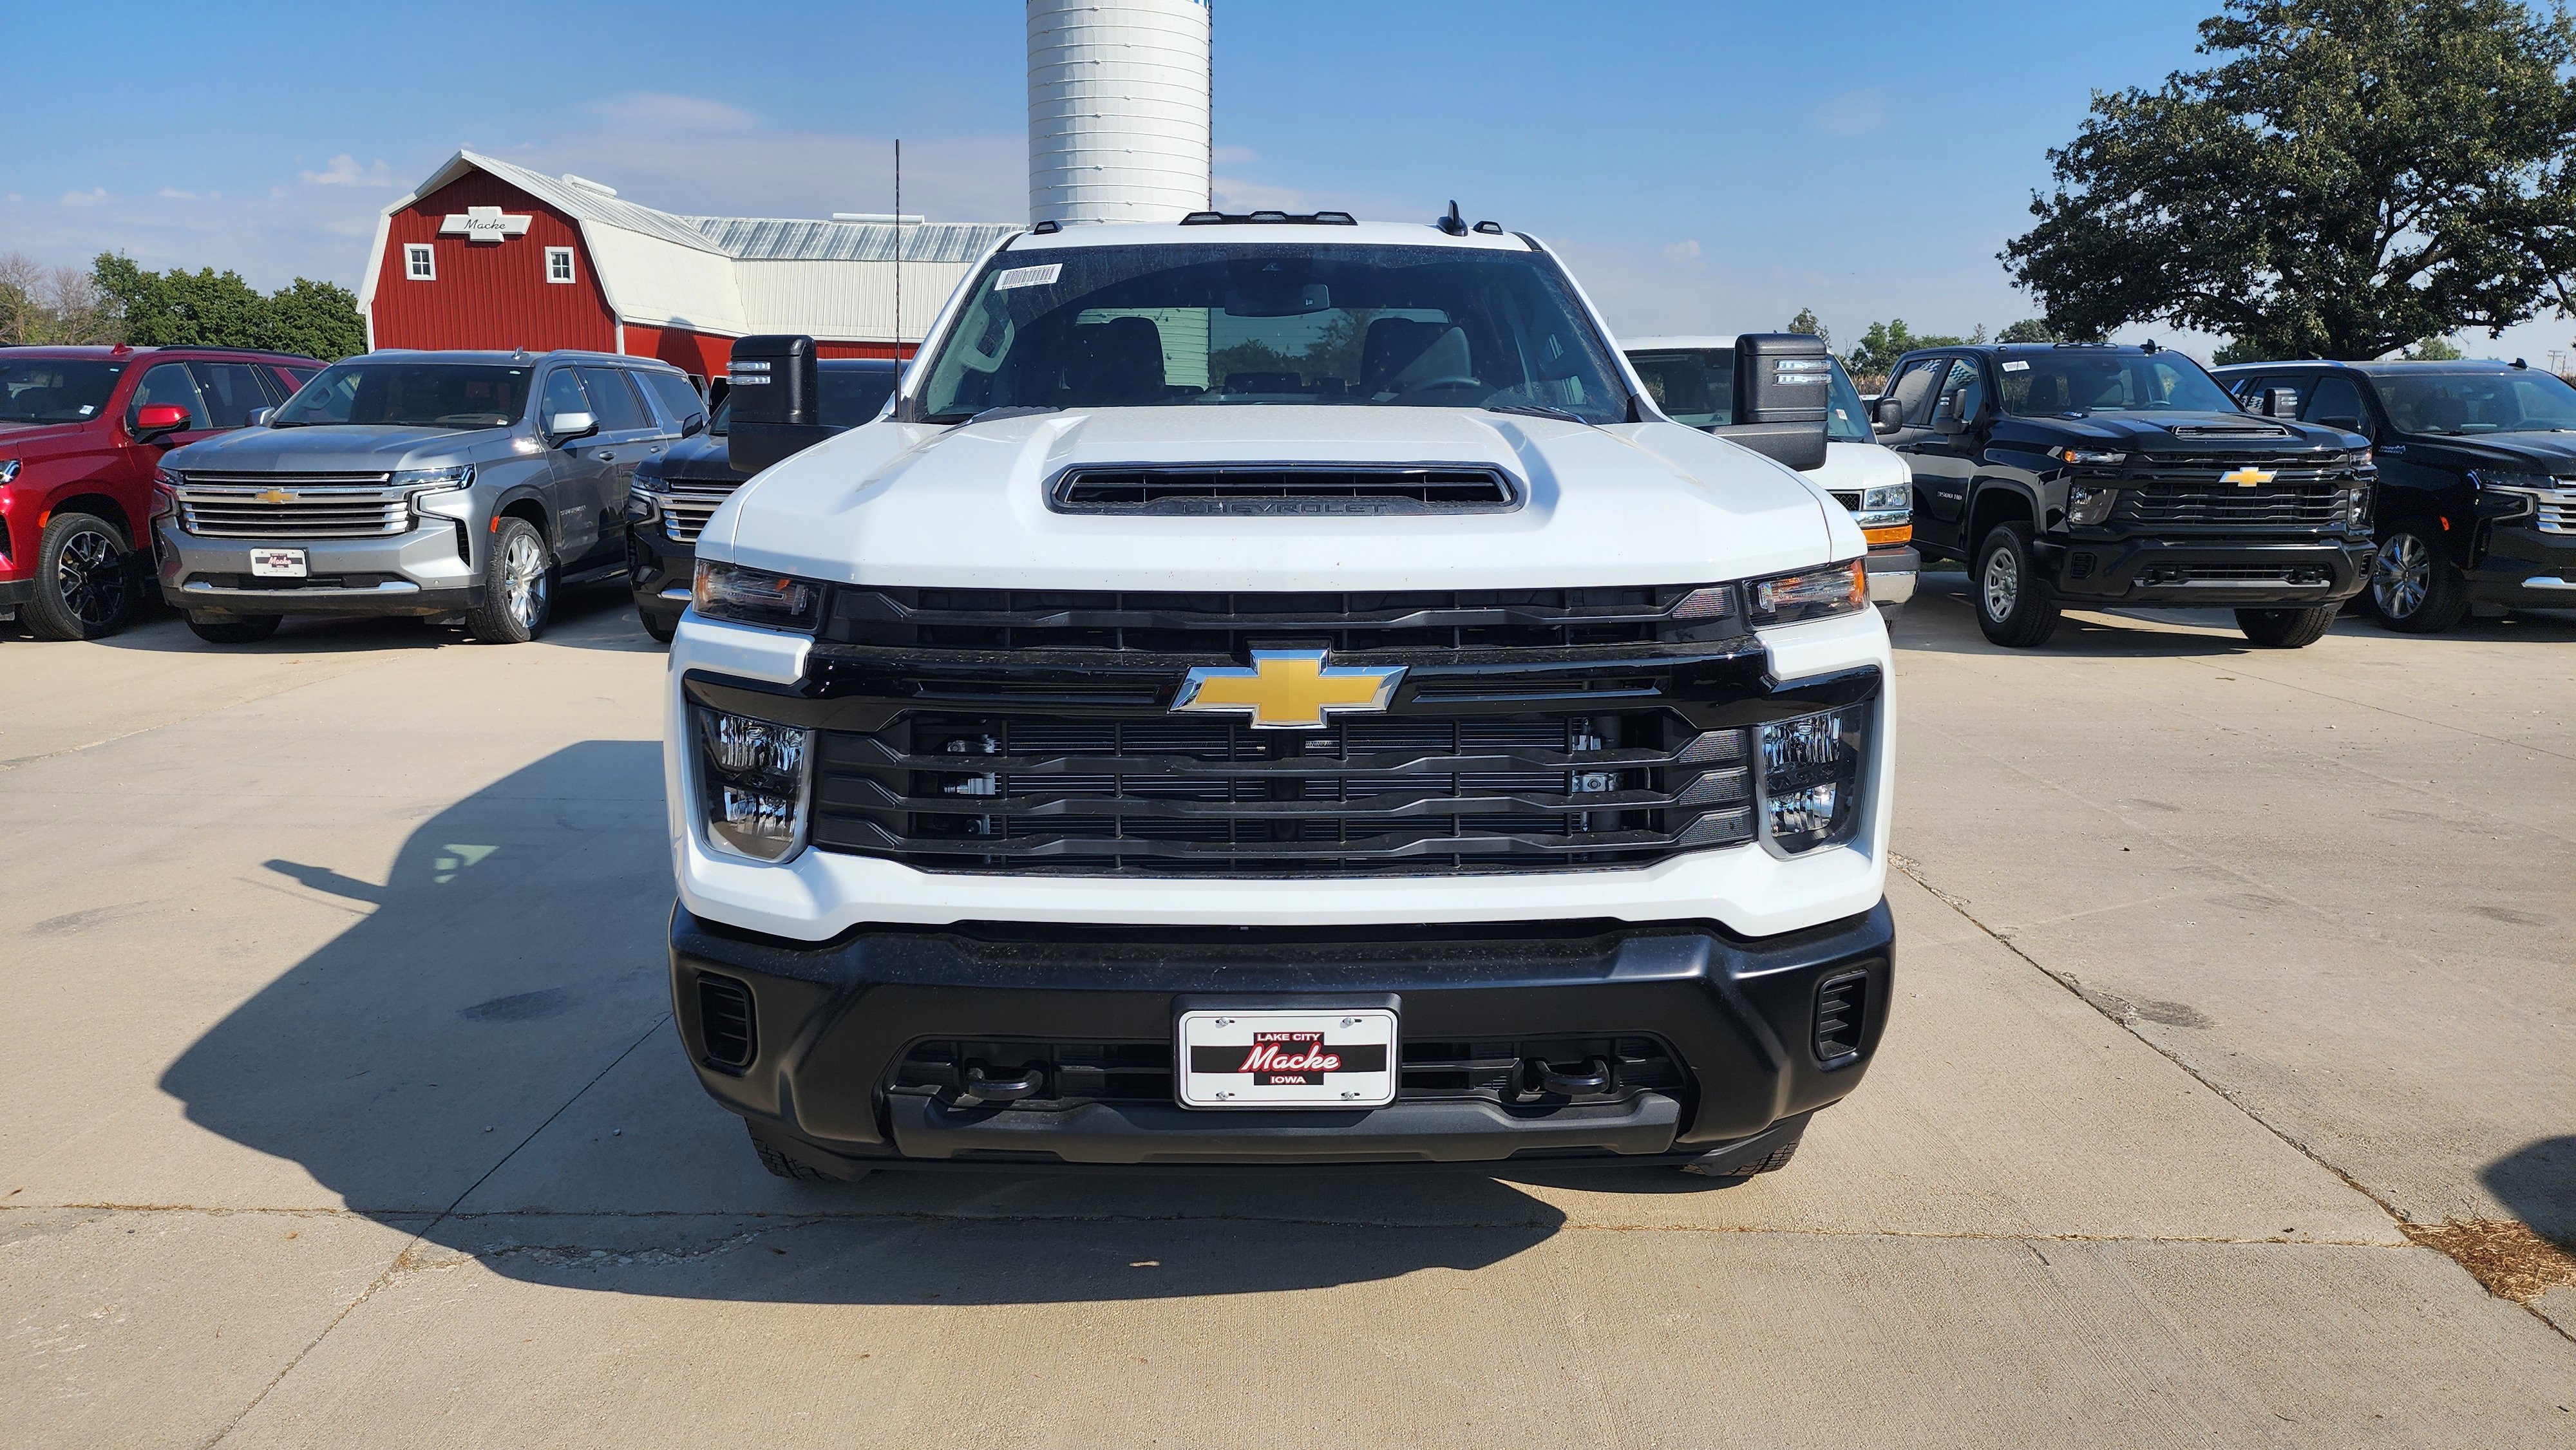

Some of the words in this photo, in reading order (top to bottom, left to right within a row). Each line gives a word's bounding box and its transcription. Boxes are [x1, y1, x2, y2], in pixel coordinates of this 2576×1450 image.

[463, 218, 507, 229] Macke
[1937, 491, 1953, 499] 3500
[1182, 503, 1388, 514] CHEVROLET
[1257, 1033, 1291, 1042] LAKE
[1292, 1033, 1321, 1042] CITY
[1240, 1043, 1340, 1071] Macke
[1271, 1075, 1307, 1084] IOWA
